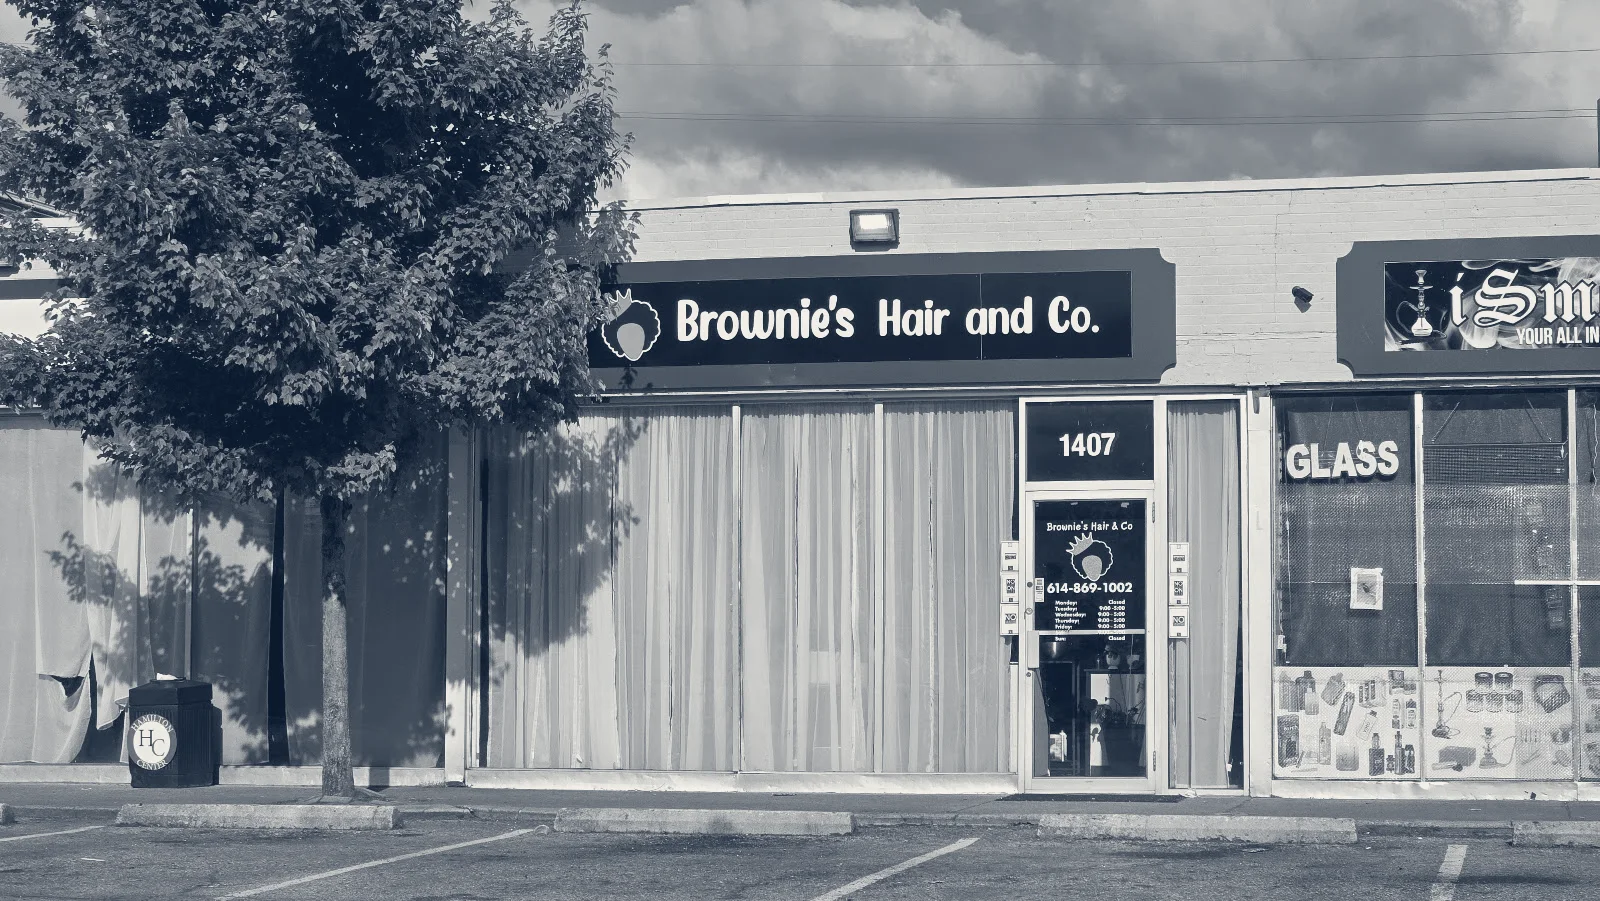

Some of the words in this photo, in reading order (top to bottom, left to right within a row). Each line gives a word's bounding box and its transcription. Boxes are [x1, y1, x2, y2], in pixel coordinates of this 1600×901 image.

[1450, 268, 1600, 327] iSm
[677, 294, 855, 342] Brownie's
[878, 298, 951, 337] Hair
[965, 295, 1033, 336] and
[1047, 295, 1101, 334] Co.
[1516, 327, 1553, 345] YOUR
[1556, 326, 1582, 344] ALL
[1585, 326, 1600, 344] IN
[1059, 432, 1116, 457] 1407
[1286, 440, 1399, 479] GLASS
[1046, 520, 1089, 532] Brownie's
[1091, 520, 1110, 532] Hair
[1111, 521, 1119, 531] &
[1120, 520, 1133, 531] Co
[1046, 582, 1133, 594] 614-869-1002
[131, 714, 174, 733] HAMILTON
[136, 759, 168, 771] CENTER
